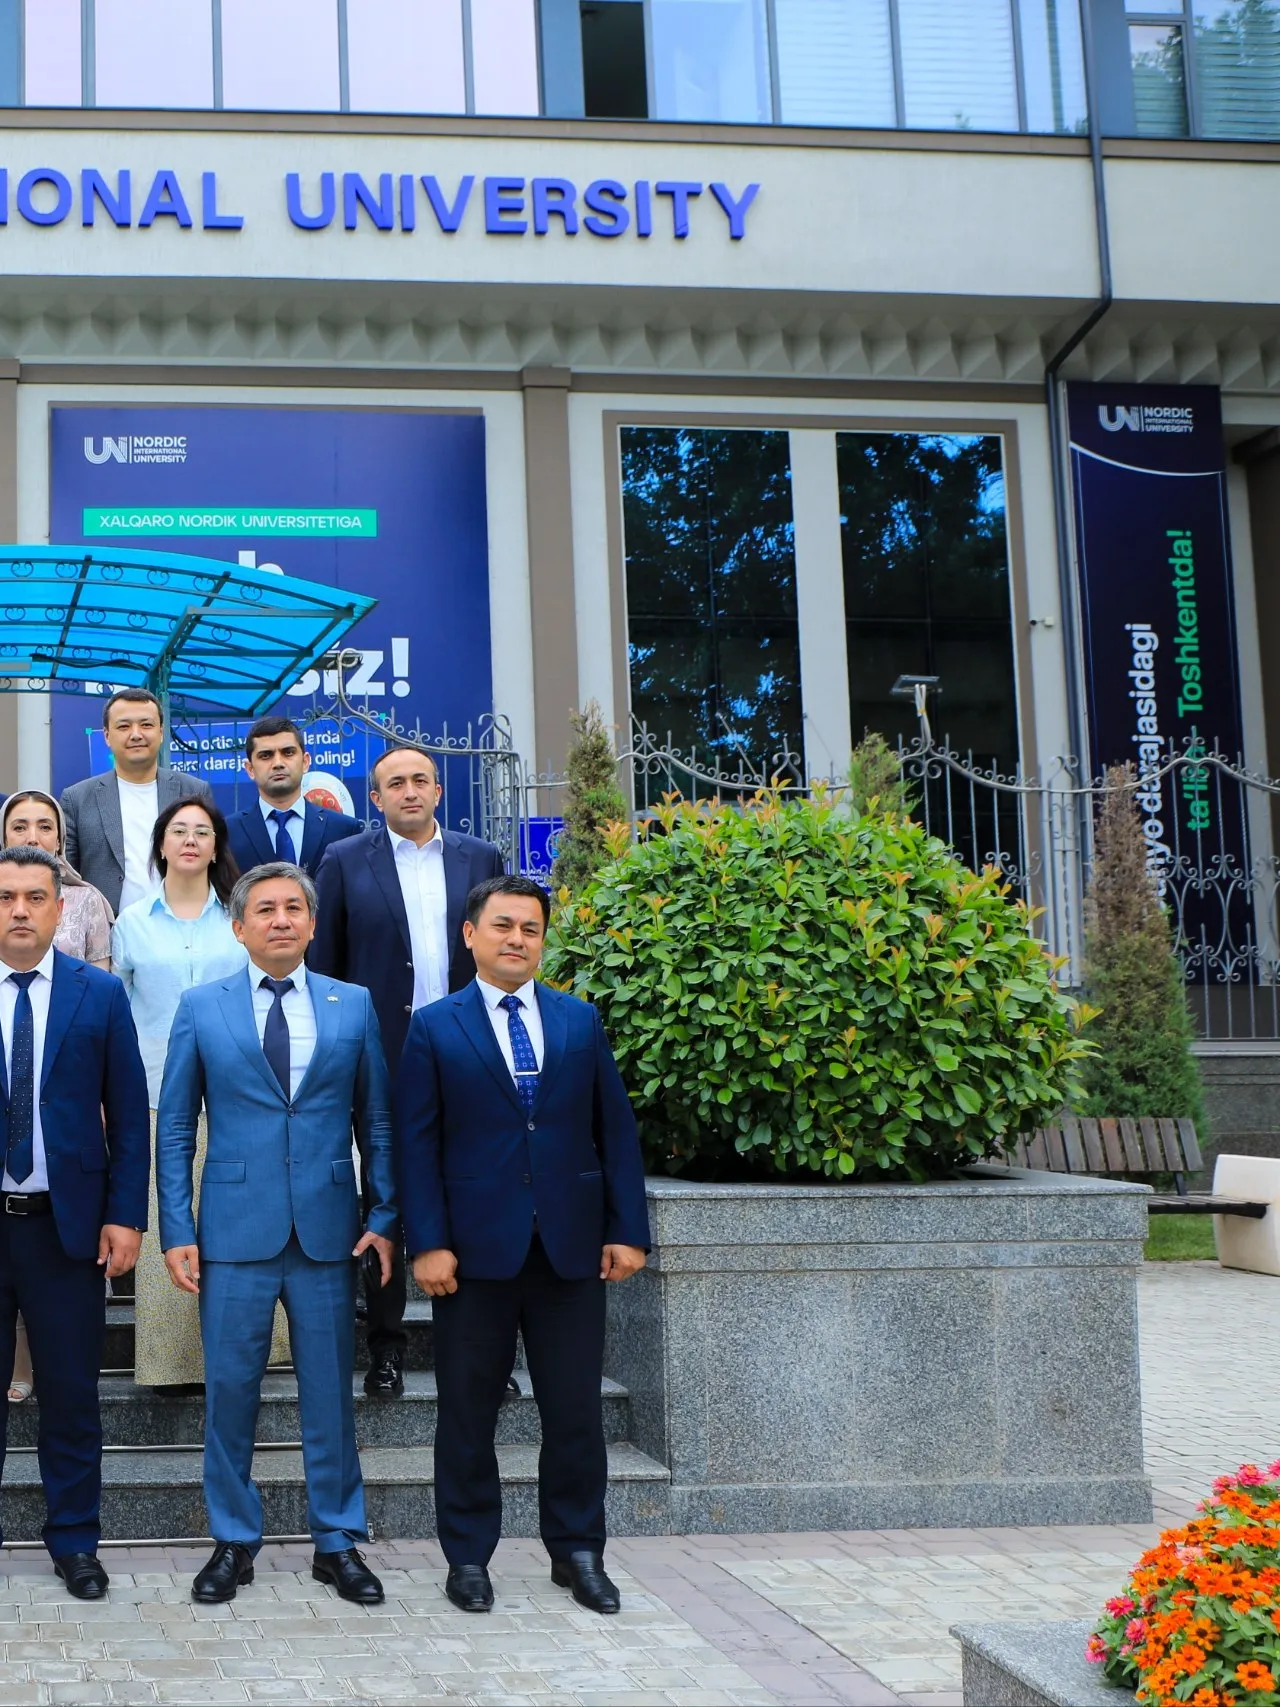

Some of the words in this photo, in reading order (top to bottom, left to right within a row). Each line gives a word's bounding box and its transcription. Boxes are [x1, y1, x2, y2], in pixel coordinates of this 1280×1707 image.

[286, 173, 760, 240] UNIVERSITY
[1144, 407, 1193, 418] NORDIC
[1144, 425, 1194, 433] UNIVERSITY
[133, 436, 187, 448] NORDIC
[133, 455, 187, 463] UNIVERSITY
[99, 515, 175, 529] XALQARO
[178, 515, 237, 527] NORDIK
[241, 515, 362, 529] UNIVERSITETIGA
[1166, 530, 1203, 717] Toshkentda!
[315, 749, 356, 767] oling!
